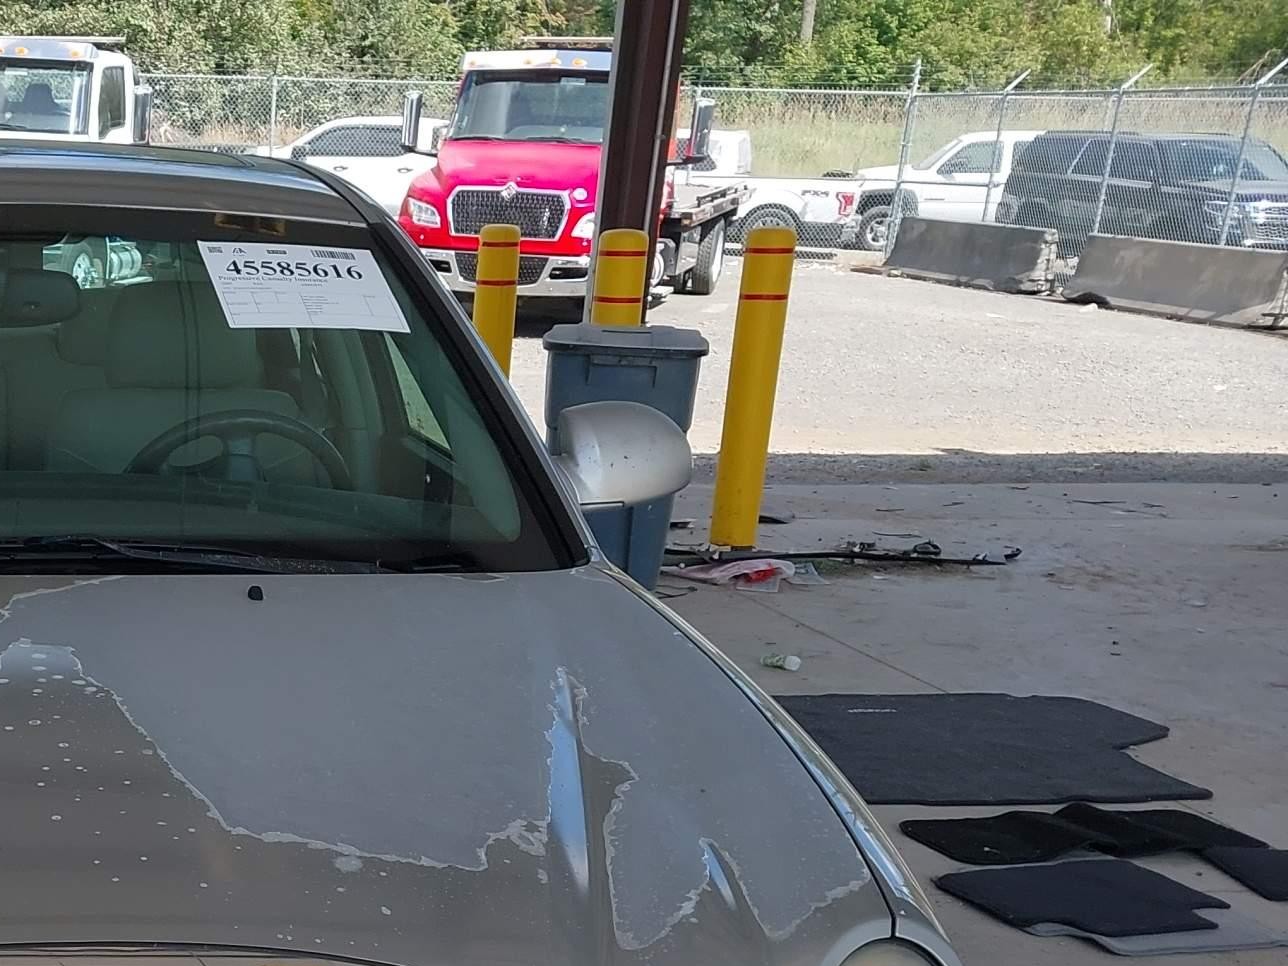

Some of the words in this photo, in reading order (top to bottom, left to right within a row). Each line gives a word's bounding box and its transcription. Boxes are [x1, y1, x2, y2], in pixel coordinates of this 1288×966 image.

[226, 259, 363, 280] 45585616
[219, 275, 261, 283] Progressive
[262, 275, 292, 283] Casualty
